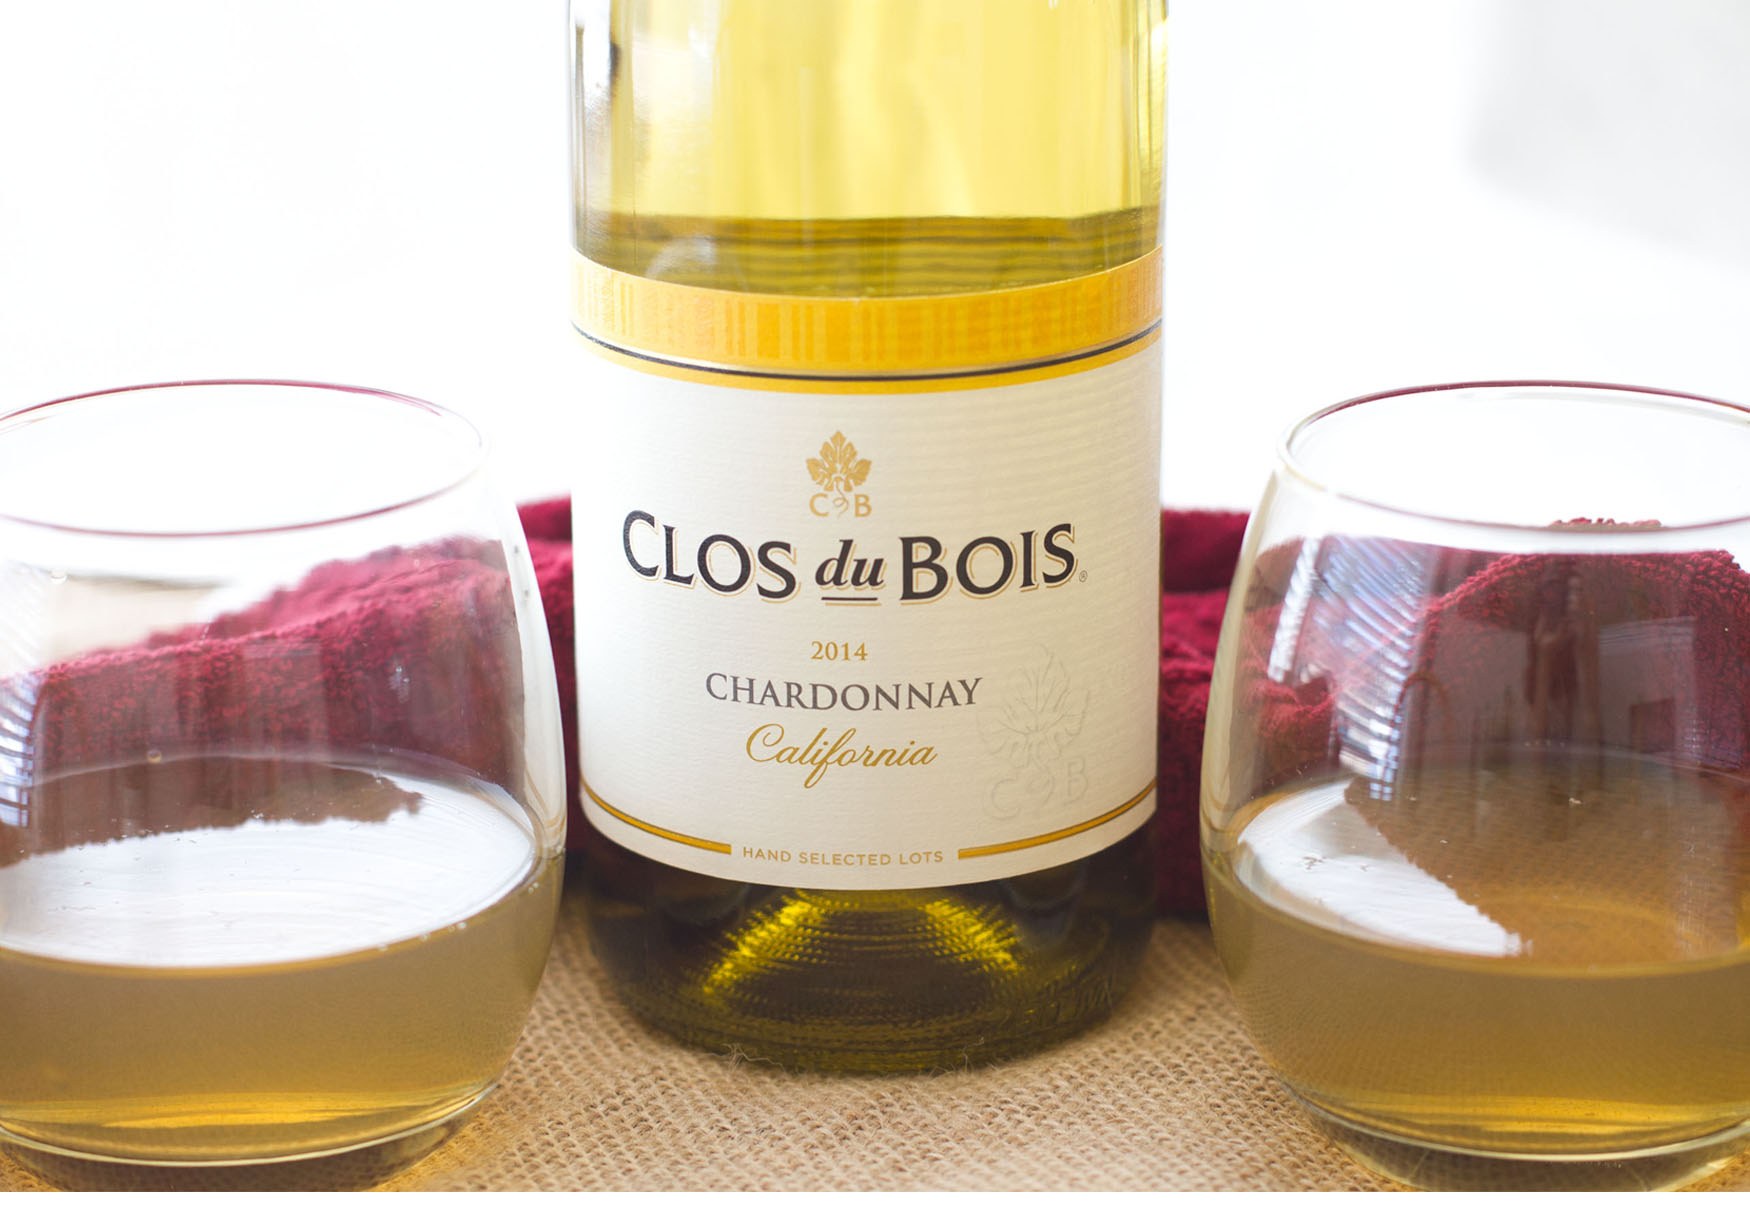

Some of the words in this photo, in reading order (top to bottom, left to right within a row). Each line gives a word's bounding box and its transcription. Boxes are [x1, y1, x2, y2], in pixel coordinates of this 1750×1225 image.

[623, 510, 799, 602] CLOS
[815, 539, 887, 591] du
[899, 523, 1077, 604] BOIS
[811, 641, 867, 661] 2014
[705, 673, 983, 711] CHARDONNAY
[746, 723, 937, 788] California
[743, 847, 791, 862] HAND
[799, 852, 891, 866] SELECTED
[899, 851, 944, 865] LOTS
